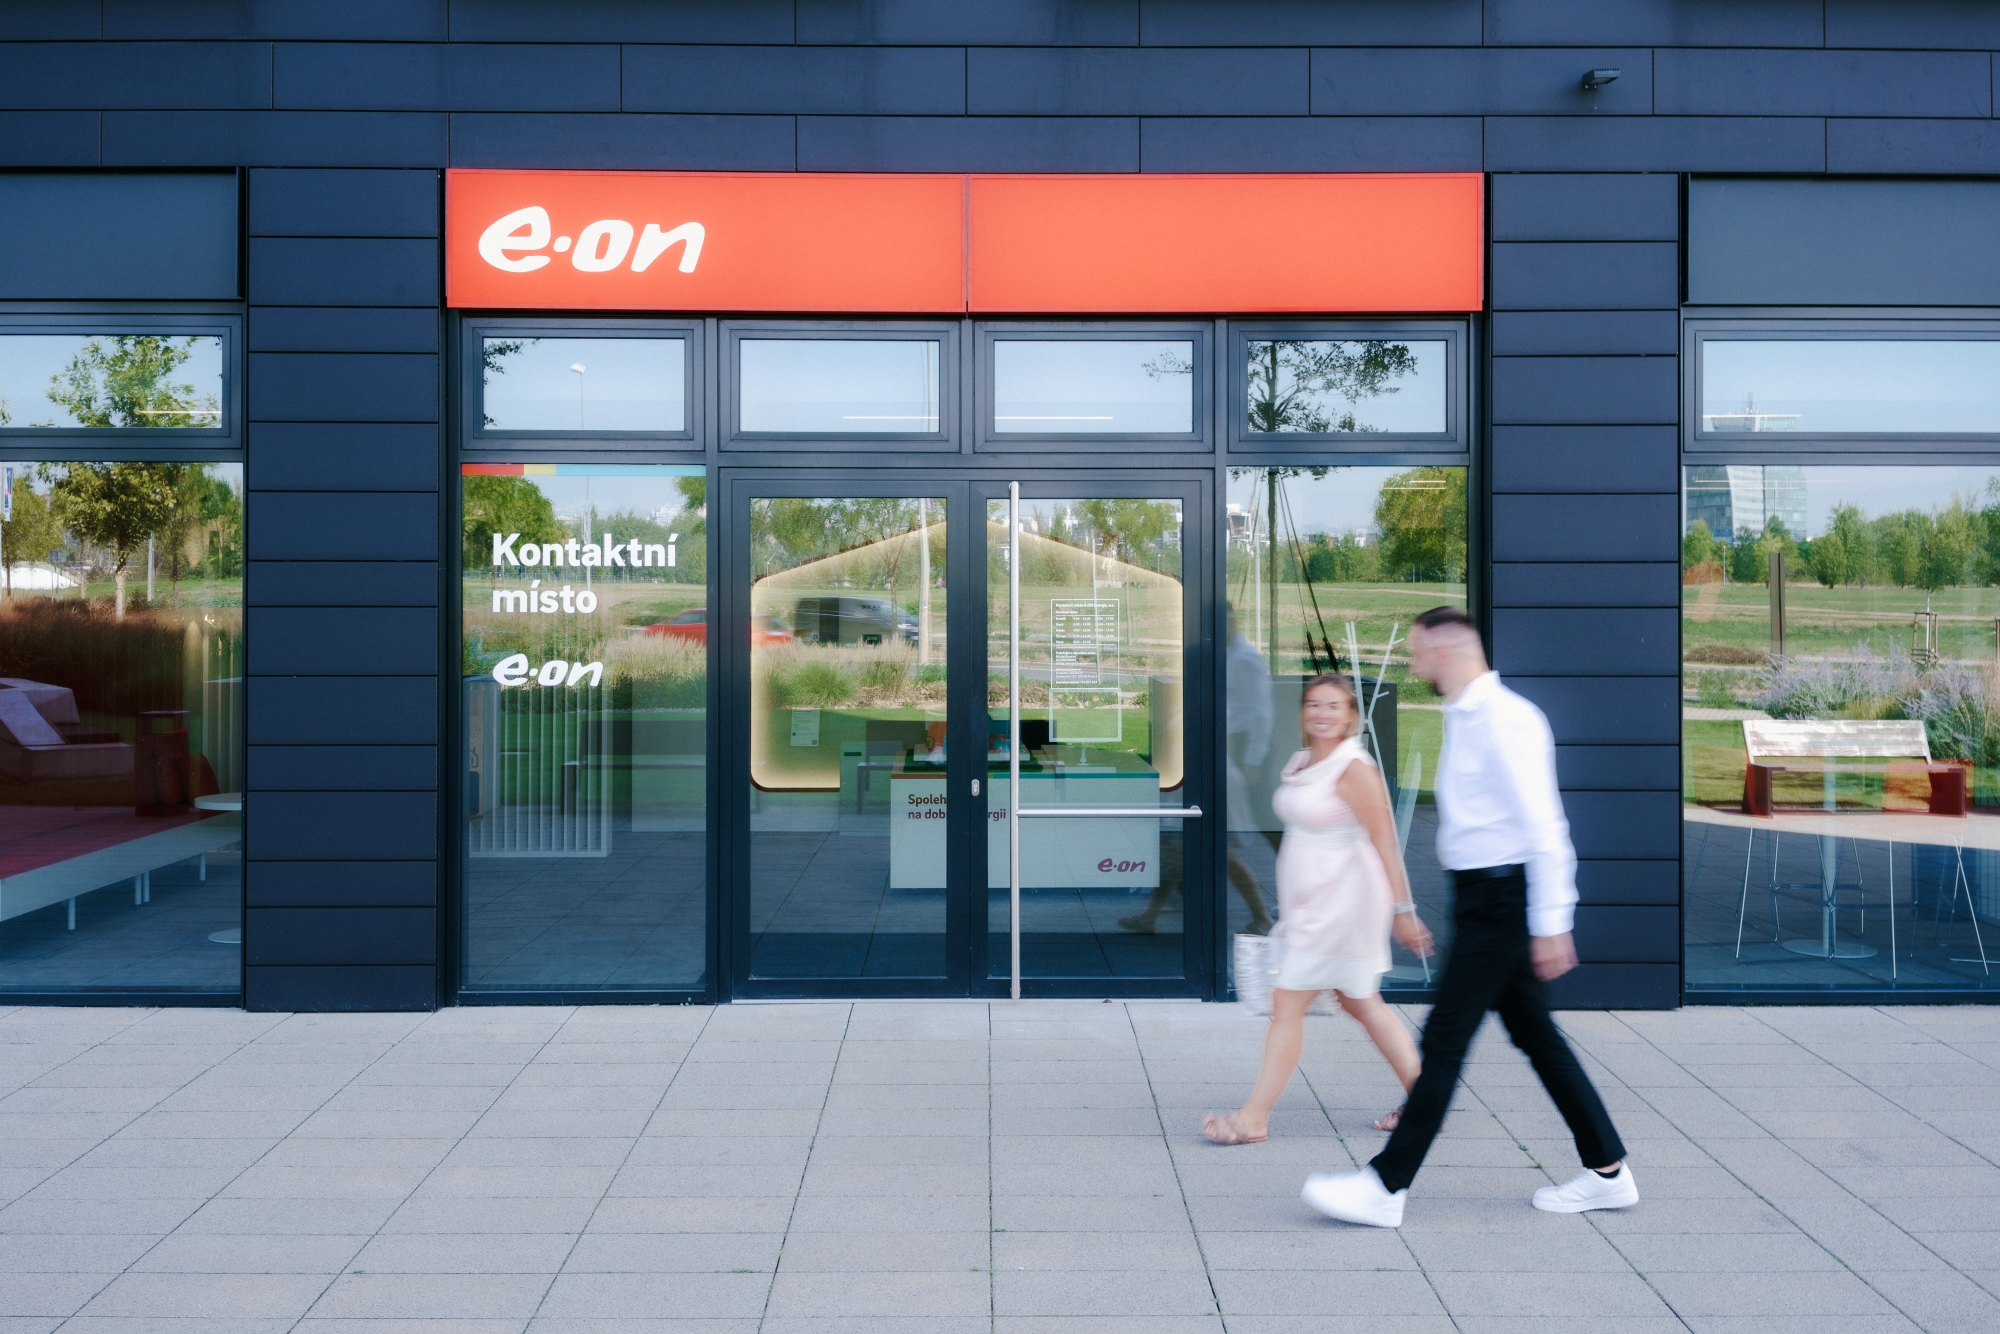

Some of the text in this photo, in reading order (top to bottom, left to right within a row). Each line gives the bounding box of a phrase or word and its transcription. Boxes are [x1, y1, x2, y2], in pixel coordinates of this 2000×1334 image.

[492, 532, 677, 567] Kontaktní
[492, 584, 598, 614] místo
[908, 794, 947, 807] Spoleh
[908, 808, 1006, 821] na dob rgii
